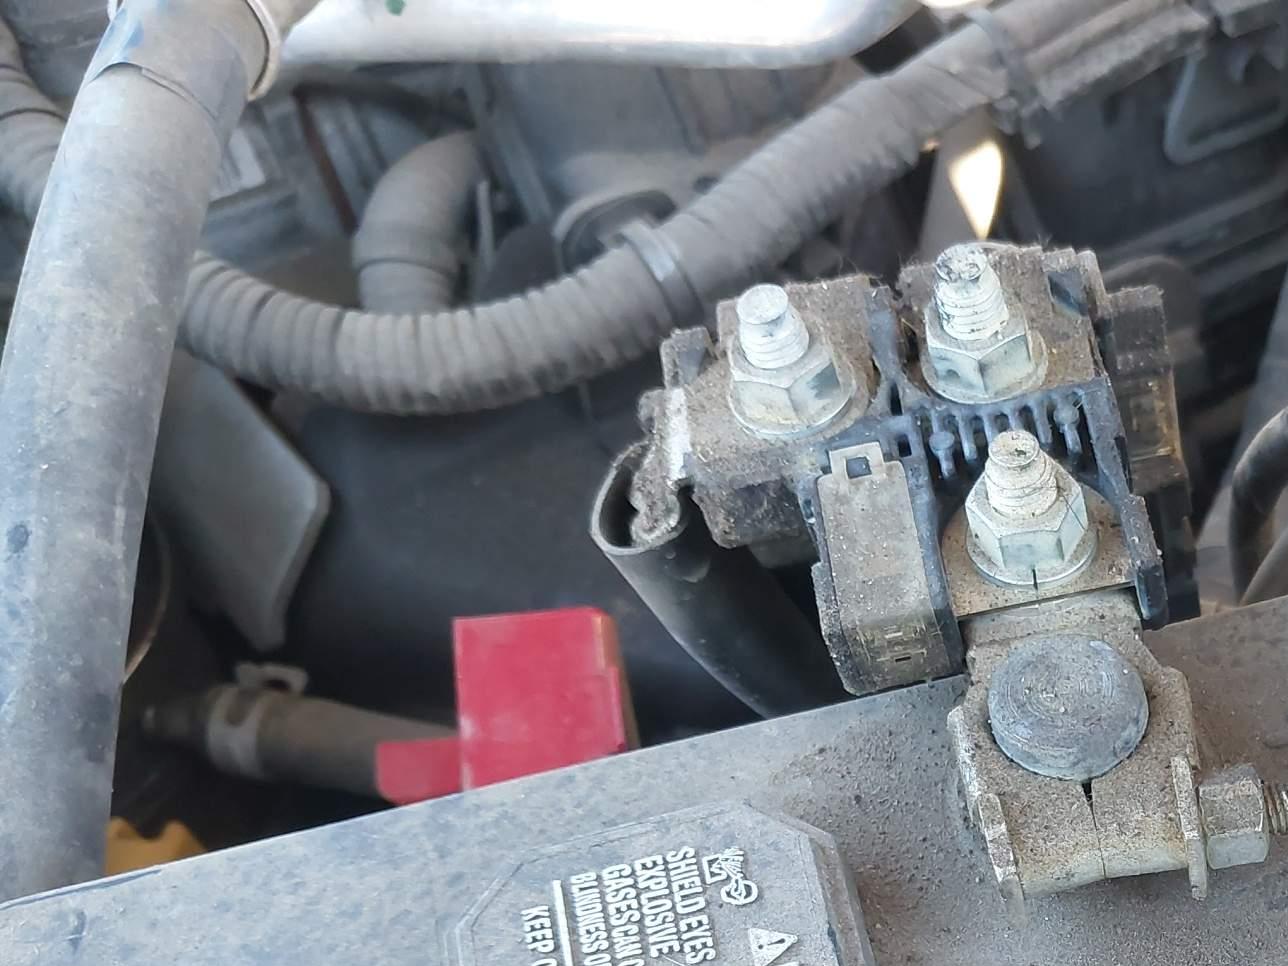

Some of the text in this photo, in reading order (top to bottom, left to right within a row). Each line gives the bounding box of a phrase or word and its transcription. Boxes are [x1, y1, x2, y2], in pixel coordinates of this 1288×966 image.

[523, 905, 554, 953] KEEP
[572, 873, 608, 953] BLINDNESS
[603, 864, 640, 926] GASES
[635, 855, 680, 958] EXPLOSIVE
[668, 846, 716, 963] SHIELD EYES
[614, 925, 642, 959] CAN
